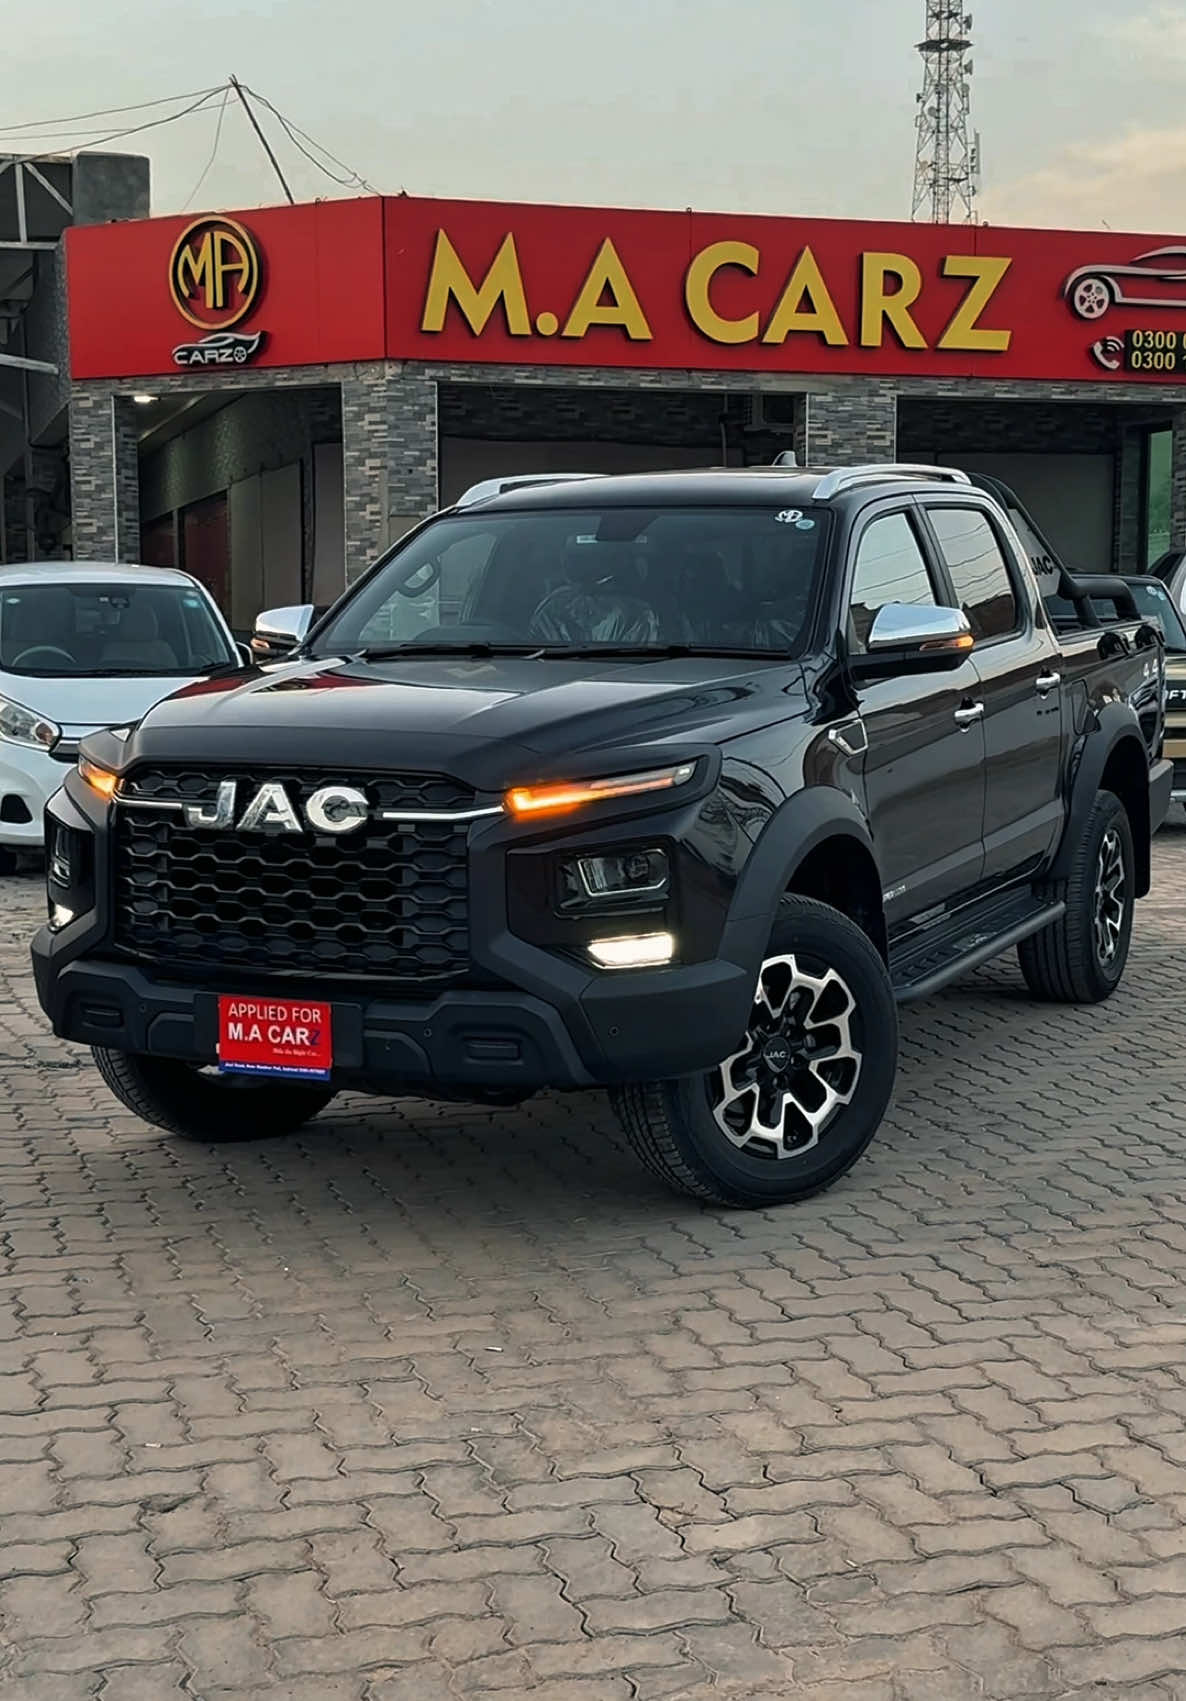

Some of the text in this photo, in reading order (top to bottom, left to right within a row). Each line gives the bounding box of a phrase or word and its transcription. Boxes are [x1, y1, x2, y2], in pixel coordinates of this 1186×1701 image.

[420, 228, 1013, 351] M.A CARZ
[1132, 329, 1177, 349] 0300
[1131, 350, 1176, 370] 0300
[187, 779, 369, 833] JAC
[228, 1002, 321, 1023] APPLIED FOR
[227, 1022, 321, 1046] M.A CARZ
